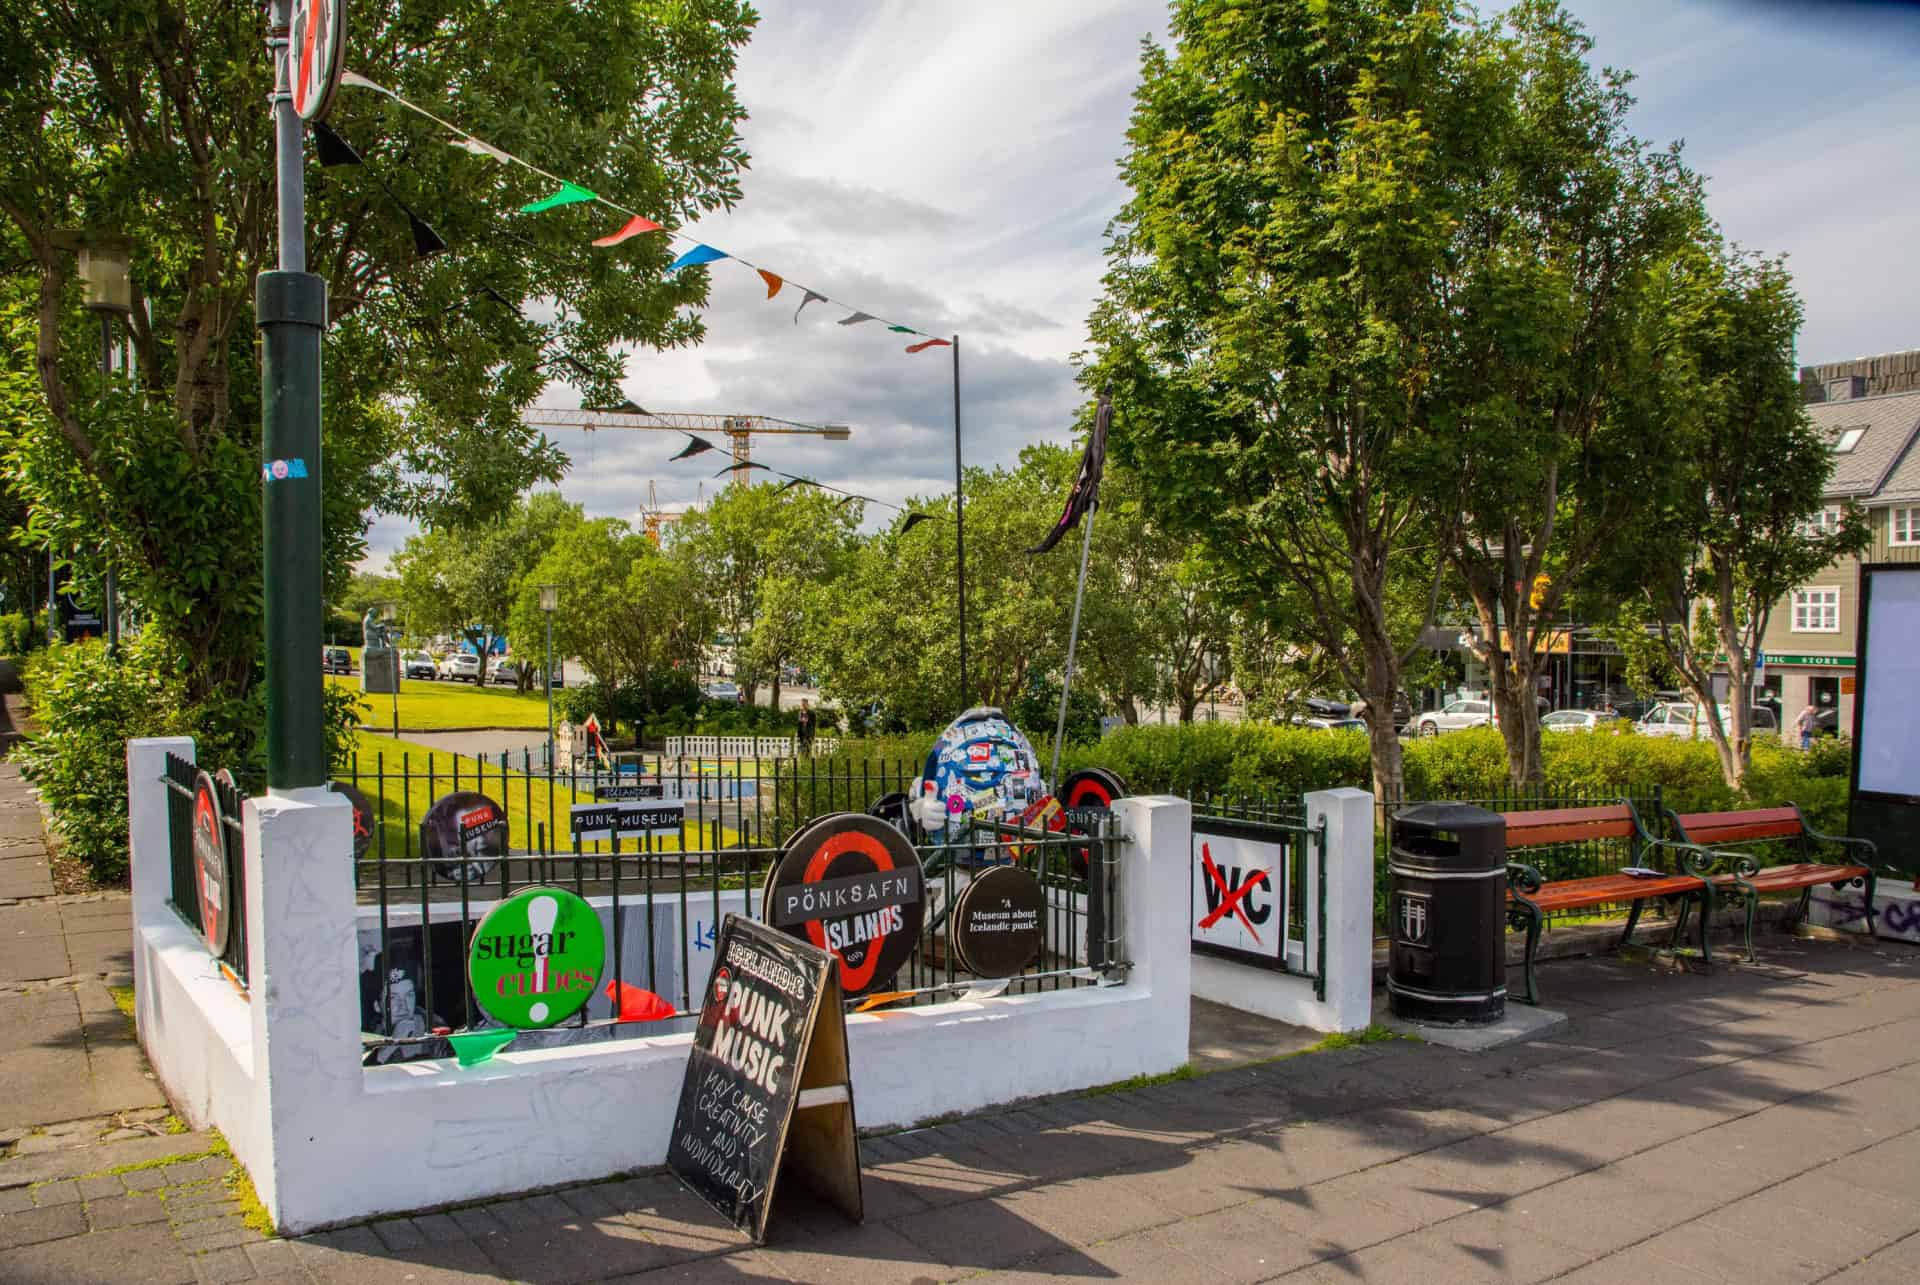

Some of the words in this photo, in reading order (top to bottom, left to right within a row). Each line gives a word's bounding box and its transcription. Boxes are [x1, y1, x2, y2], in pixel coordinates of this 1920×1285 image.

[1801, 656, 1839, 665] STORE
[621, 814, 679, 827] MUSEUM
[787, 877, 908, 914] PÖNKSAFN
[973, 911, 1010, 921] Museum
[1012, 909, 1037, 919] about
[1202, 861, 1272, 924] WC
[477, 930, 576, 969] sugar
[824, 904, 903, 953] ÍSLANDS
[969, 921, 1010, 933] Icelandic
[496, 957, 595, 998] cubes
[727, 941, 805, 999] ICELANDIC
[725, 980, 790, 1047] PUNK
[712, 1019, 784, 1094] MUSIC
[704, 1071, 735, 1098] MAY
[731, 1089, 769, 1125] CAUSE
[699, 1094, 768, 1149] CREATIVITY
[680, 1132, 765, 1203] INDIVIDUALITY
[711, 1131, 737, 1159] AND
